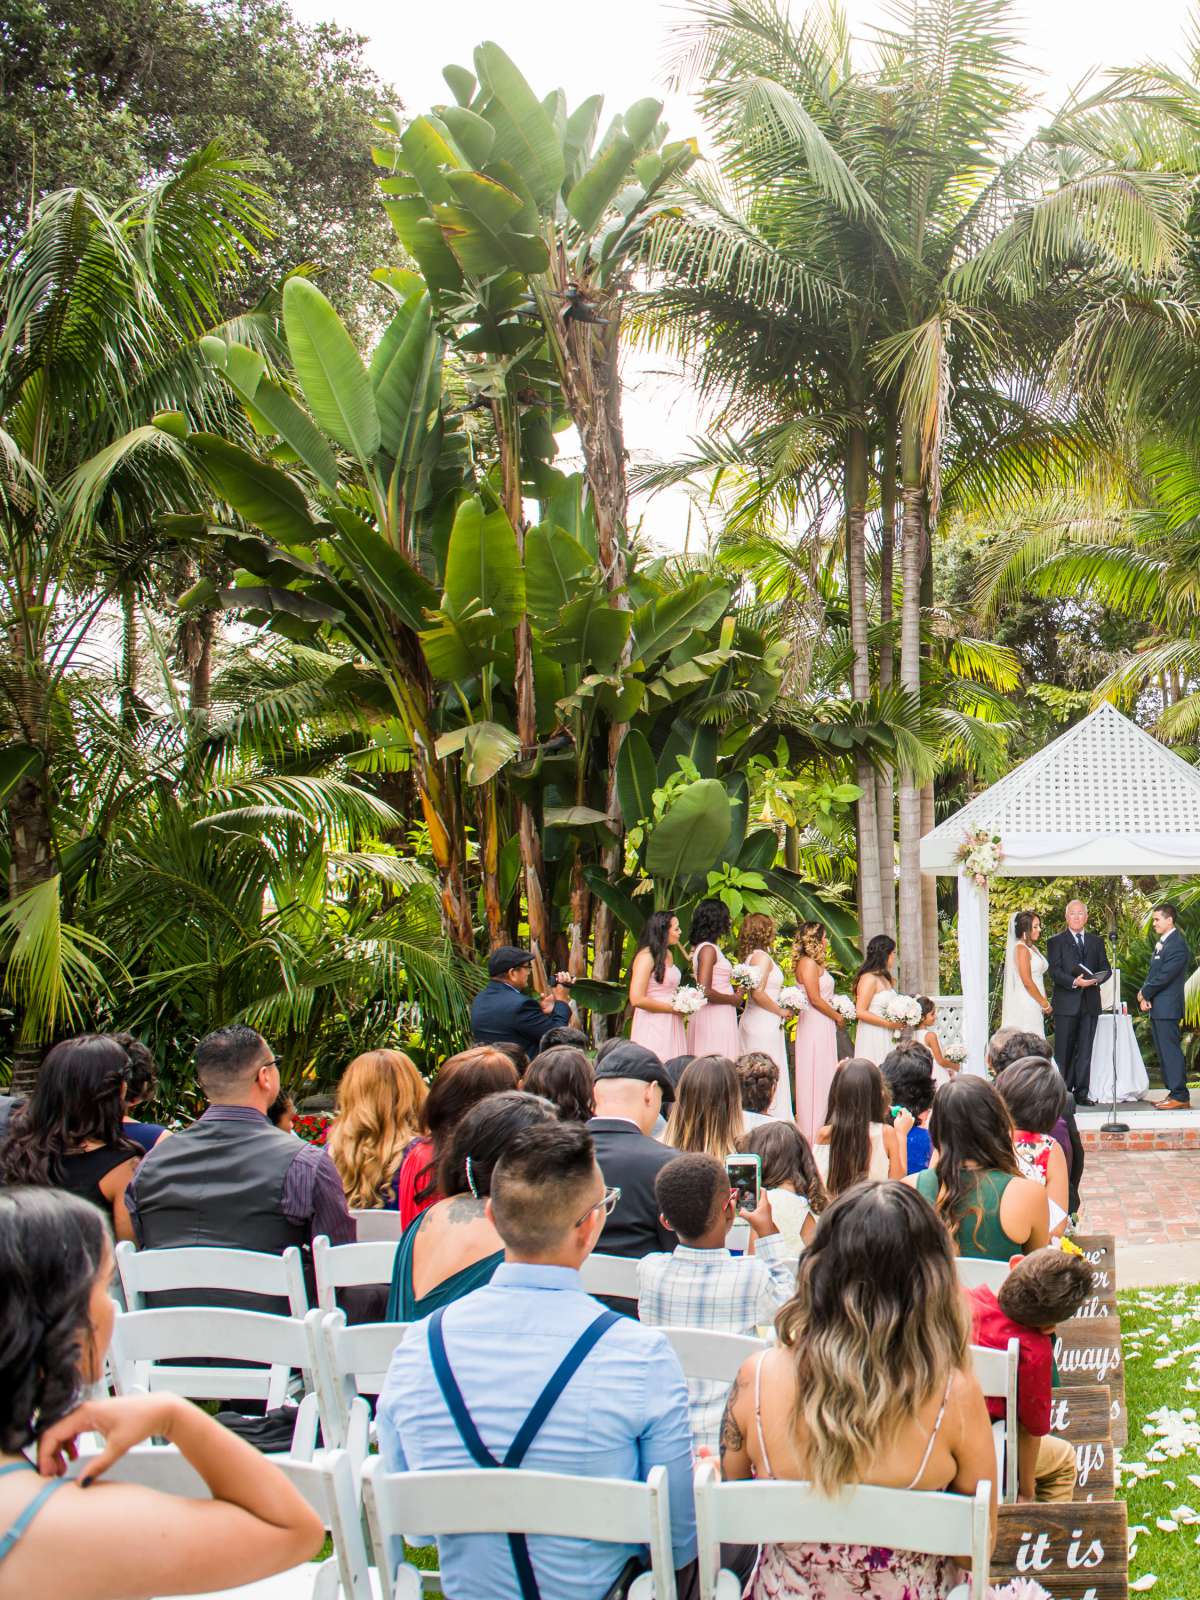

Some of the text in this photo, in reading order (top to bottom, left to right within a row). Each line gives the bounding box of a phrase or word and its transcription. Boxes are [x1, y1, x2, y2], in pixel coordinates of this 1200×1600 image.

[1053, 1336, 1121, 1382] lways
[1016, 1530, 1105, 1572] it is
